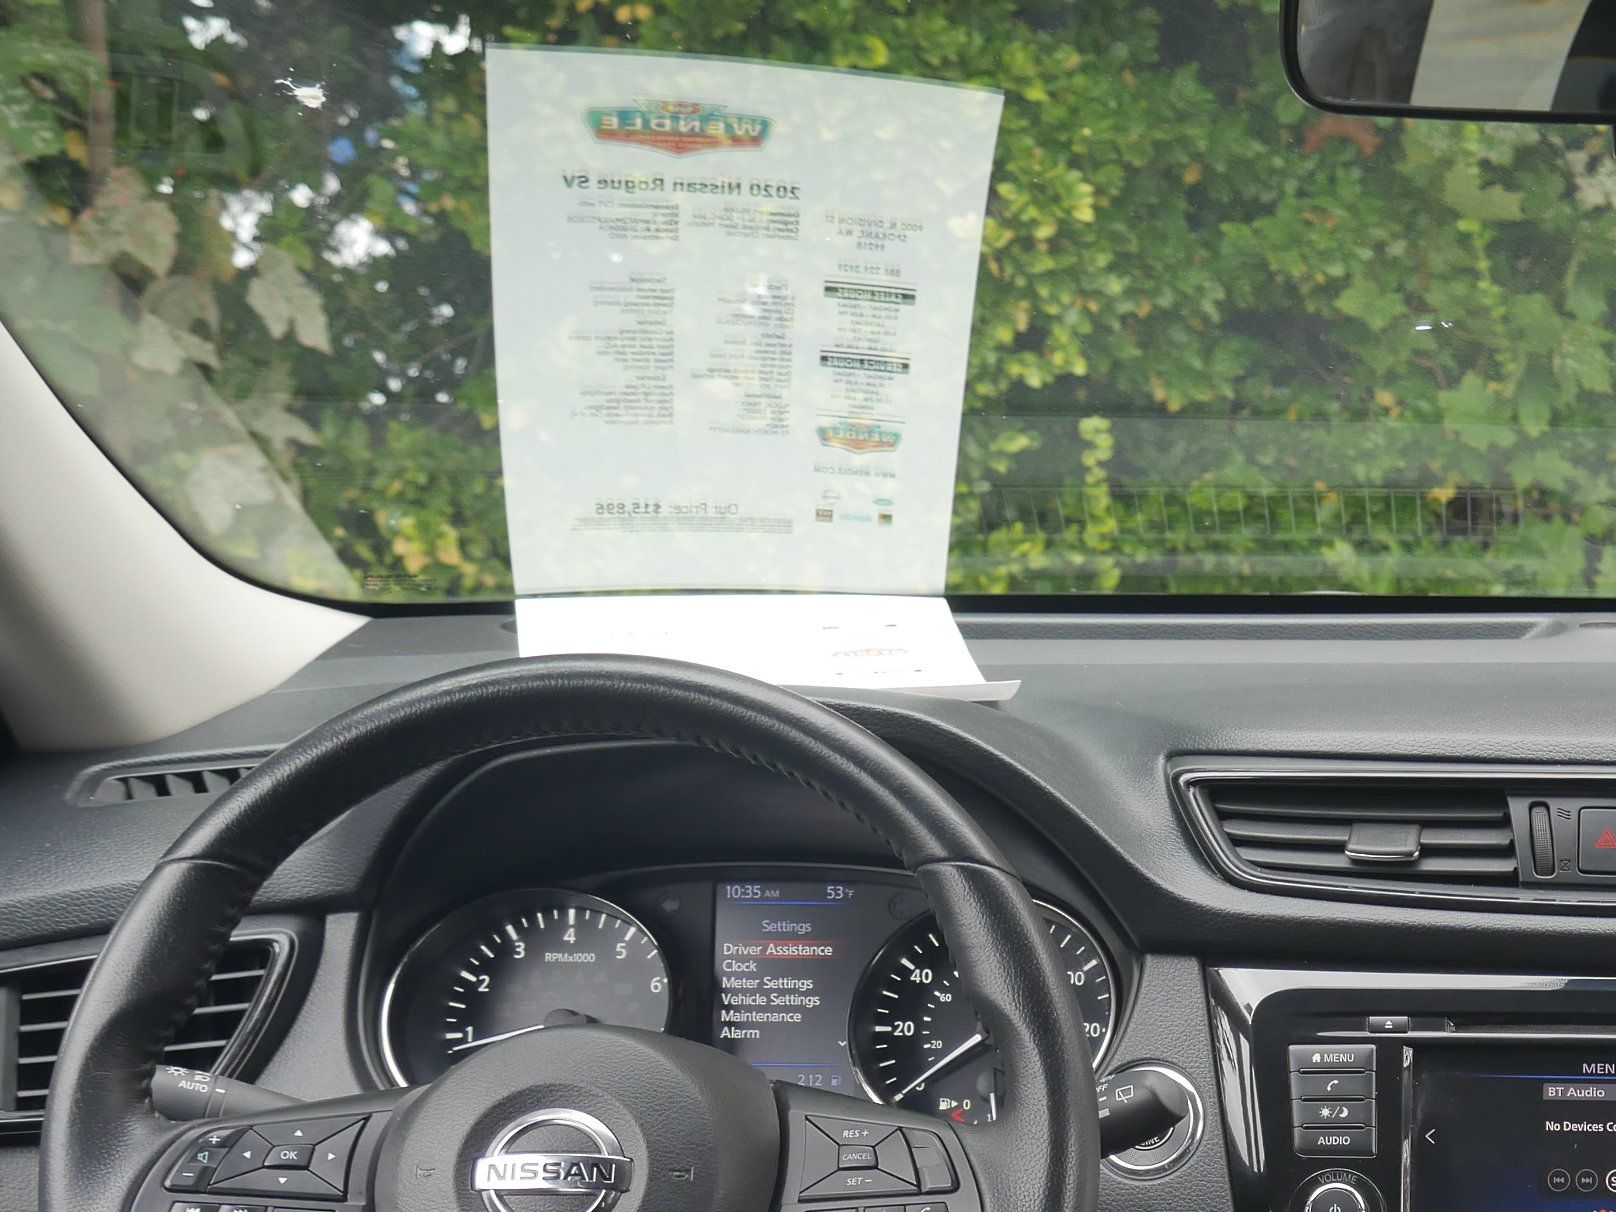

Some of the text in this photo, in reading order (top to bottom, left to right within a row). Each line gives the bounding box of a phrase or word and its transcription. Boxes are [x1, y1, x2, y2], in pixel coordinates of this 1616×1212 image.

[725, 886, 780, 899] 10:35 AM
[762, 920, 812, 934] Settings
[563, 928, 576, 944] 4
[513, 941, 526, 959] 3
[615, 943, 627, 959] 5
[723, 943, 833, 956] Driver Assistance
[545, 953, 595, 963] RPMx1000
[723, 960, 757, 972] Clock
[910, 969, 933, 984] 40
[478, 975, 490, 992] 2
[650, 977, 662, 992] 6
[722, 977, 813, 991] Meter Settings
[722, 993, 820, 1007] Vehicle Settings
[940, 994, 952, 1002] 60
[721, 1010, 802, 1023] Maintenance
[466, 1026, 474, 1042] 1
[720, 1026, 760, 1039] Alarm
[893, 1022, 915, 1036] 20
[931, 1040, 943, 1049] 20
[1323, 1053, 1355, 1063] MENU
[178, 1080, 208, 1093] AUTO
[1548, 1086, 1606, 1098] BT Audio
[1545, 1121, 1561, 1132] No
[1563, 1121, 1604, 1132] Devices
[842, 1129, 860, 1138] RES
[1317, 1136, 1351, 1145] AUDIO
[280, 1150, 298, 1160] OK
[842, 1152, 873, 1161] CANCEL
[487, 1162, 616, 1184] NISSAN
[1317, 1172, 1358, 1185] VOLUME
[846, 1177, 863, 1186] SET
